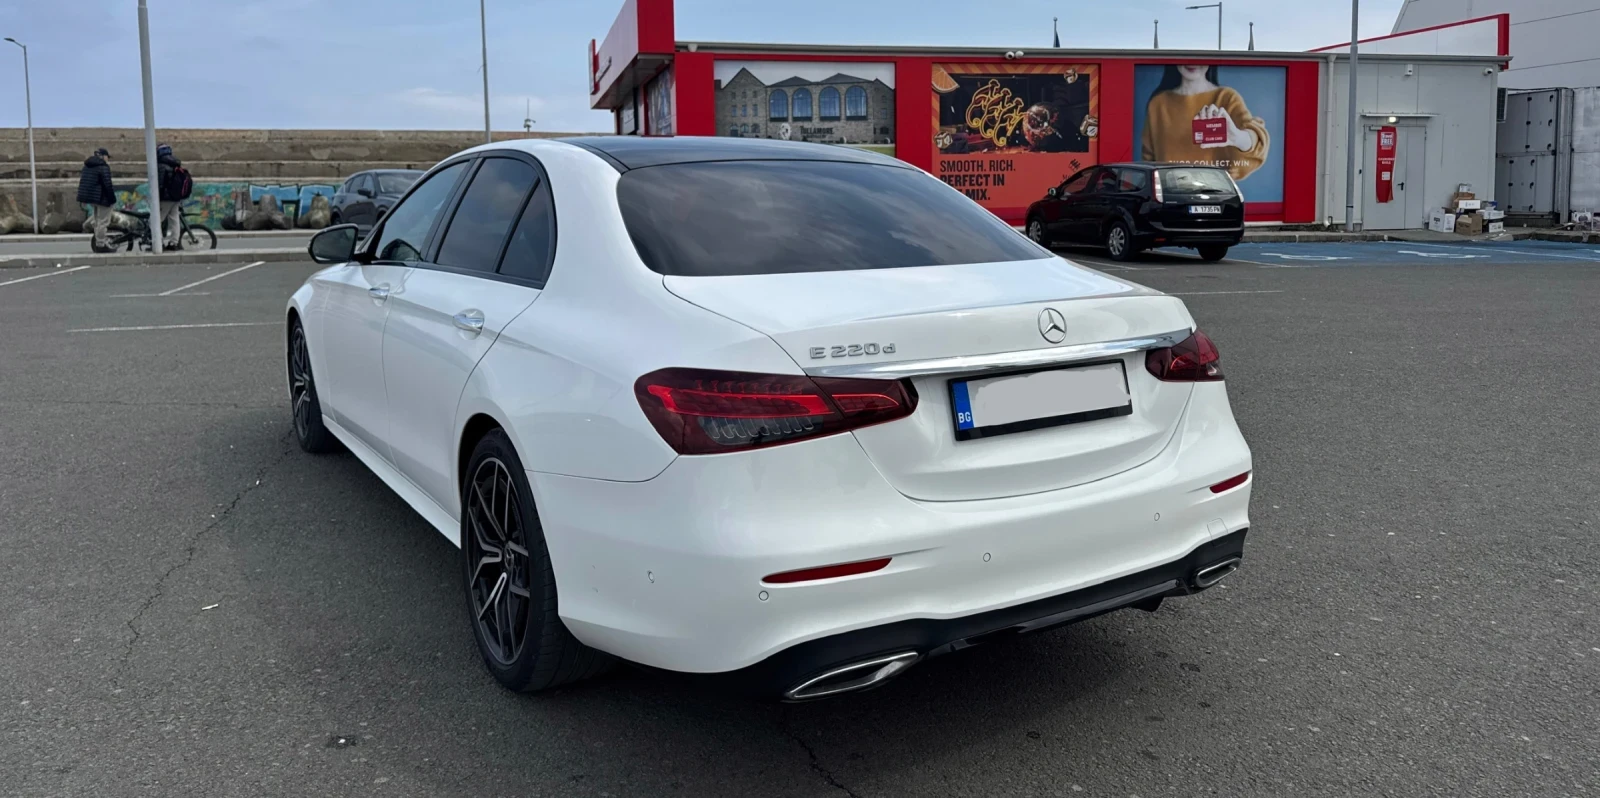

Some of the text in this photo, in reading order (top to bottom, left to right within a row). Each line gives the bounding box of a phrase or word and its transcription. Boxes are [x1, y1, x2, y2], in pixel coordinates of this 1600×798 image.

[939, 159, 1016, 172] SMOOTH. RICH.
[939, 173, 1005, 187] PERFECT IN
[809, 346, 826, 359] E
[957, 411, 972, 424] BG
